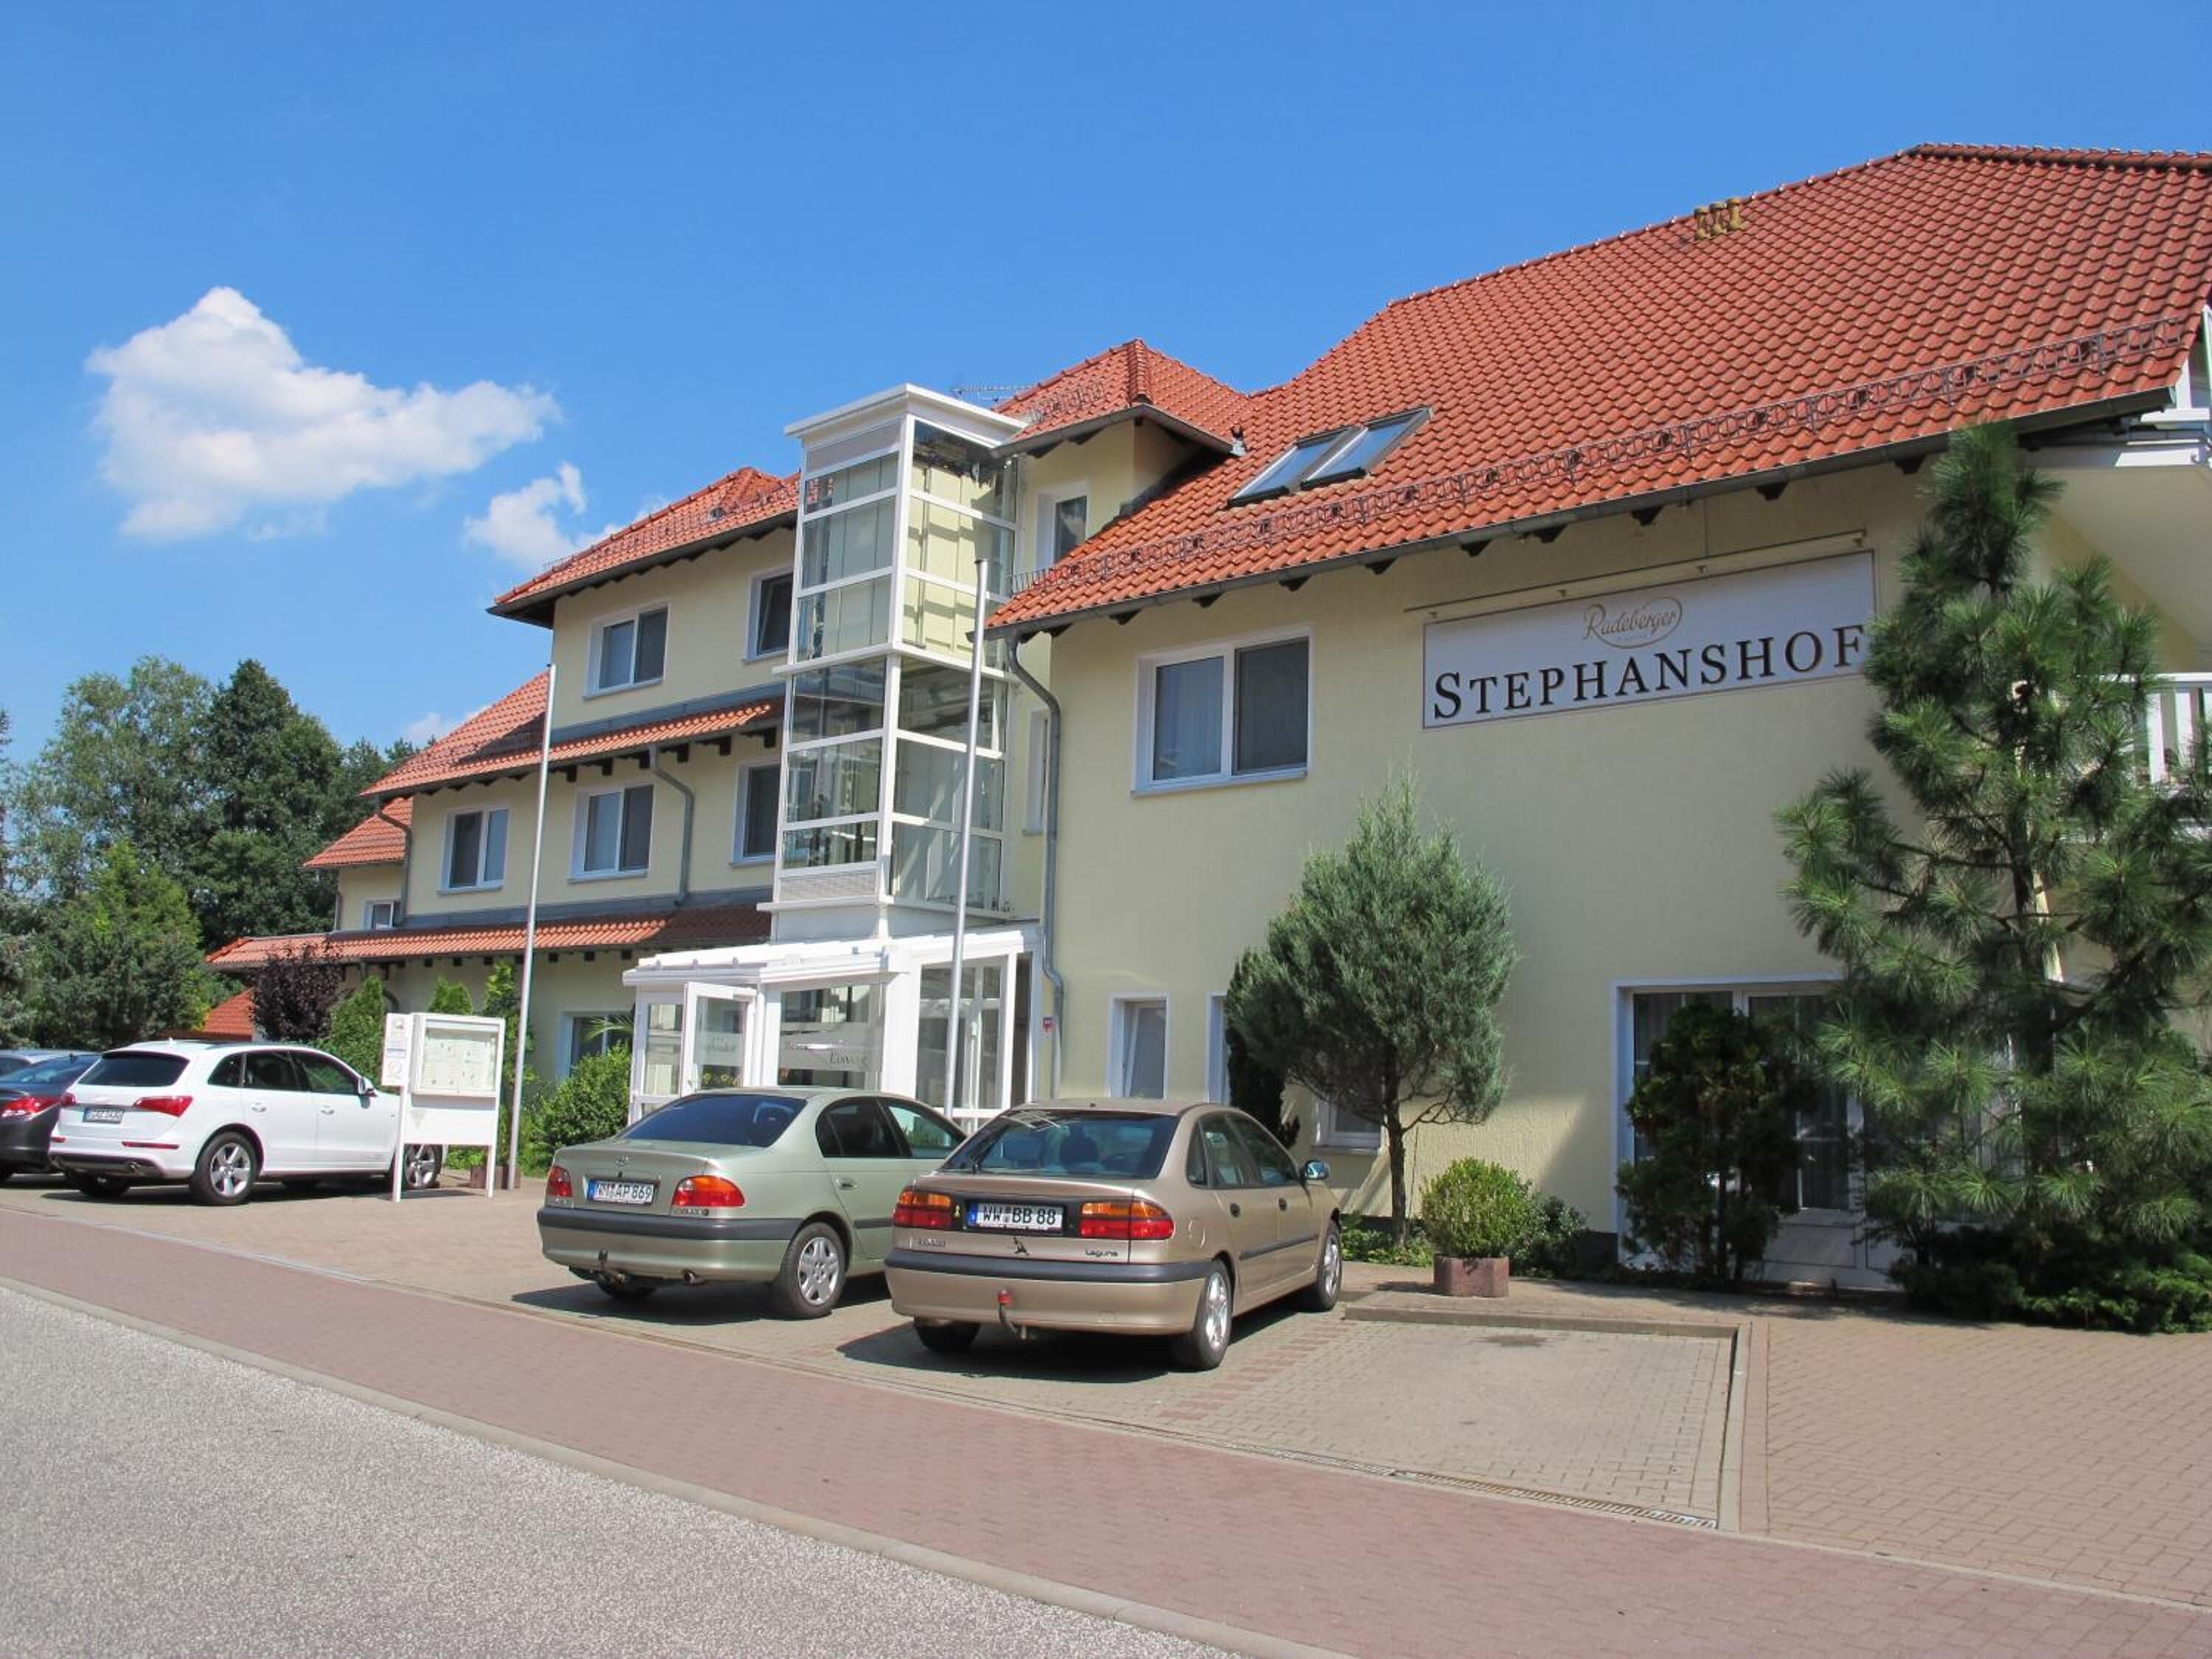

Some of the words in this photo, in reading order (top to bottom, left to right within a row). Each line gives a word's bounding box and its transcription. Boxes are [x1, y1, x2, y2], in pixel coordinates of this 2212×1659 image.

[1582, 602, 1677, 640] Radeberger
[1433, 625, 1865, 720] STEPHANSHOF
[616, 1183, 630, 1198] AP
[632, 1185, 653, 1200] 869
[1012, 1207, 1033, 1224] BB
[1037, 1208, 1057, 1225] 88
